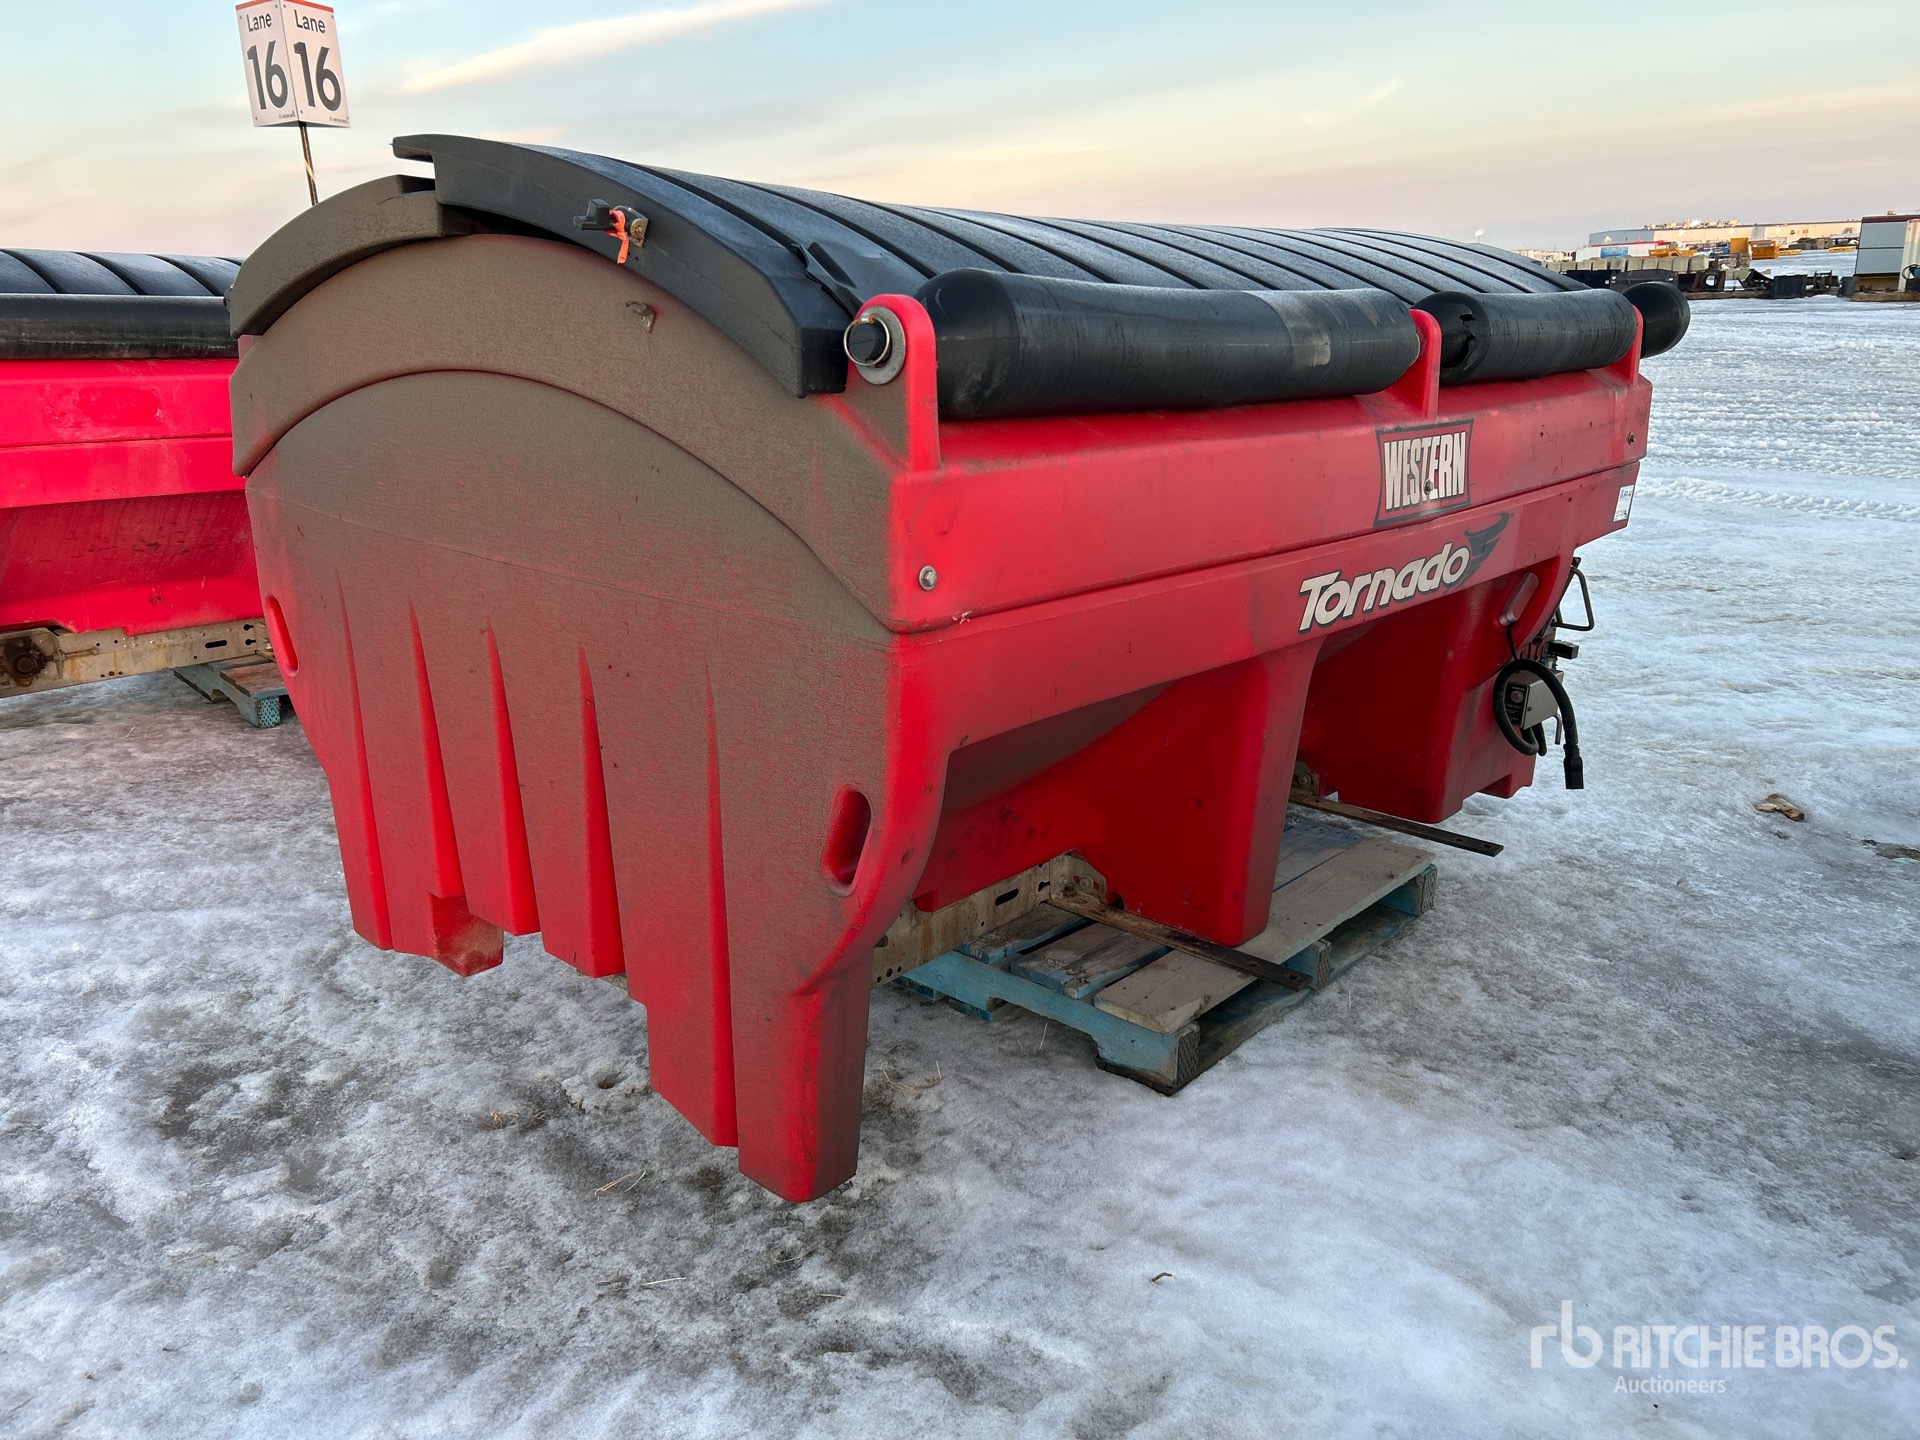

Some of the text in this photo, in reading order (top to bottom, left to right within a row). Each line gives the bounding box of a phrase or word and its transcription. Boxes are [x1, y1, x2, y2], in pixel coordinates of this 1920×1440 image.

[246, 13, 272, 32] Lane
[294, 9, 326, 34] Lane
[246, 40, 288, 110] 16
[293, 41, 342, 112] 16
[1383, 431, 1466, 511] WESTERN
[1298, 541, 1471, 633] Tornado
